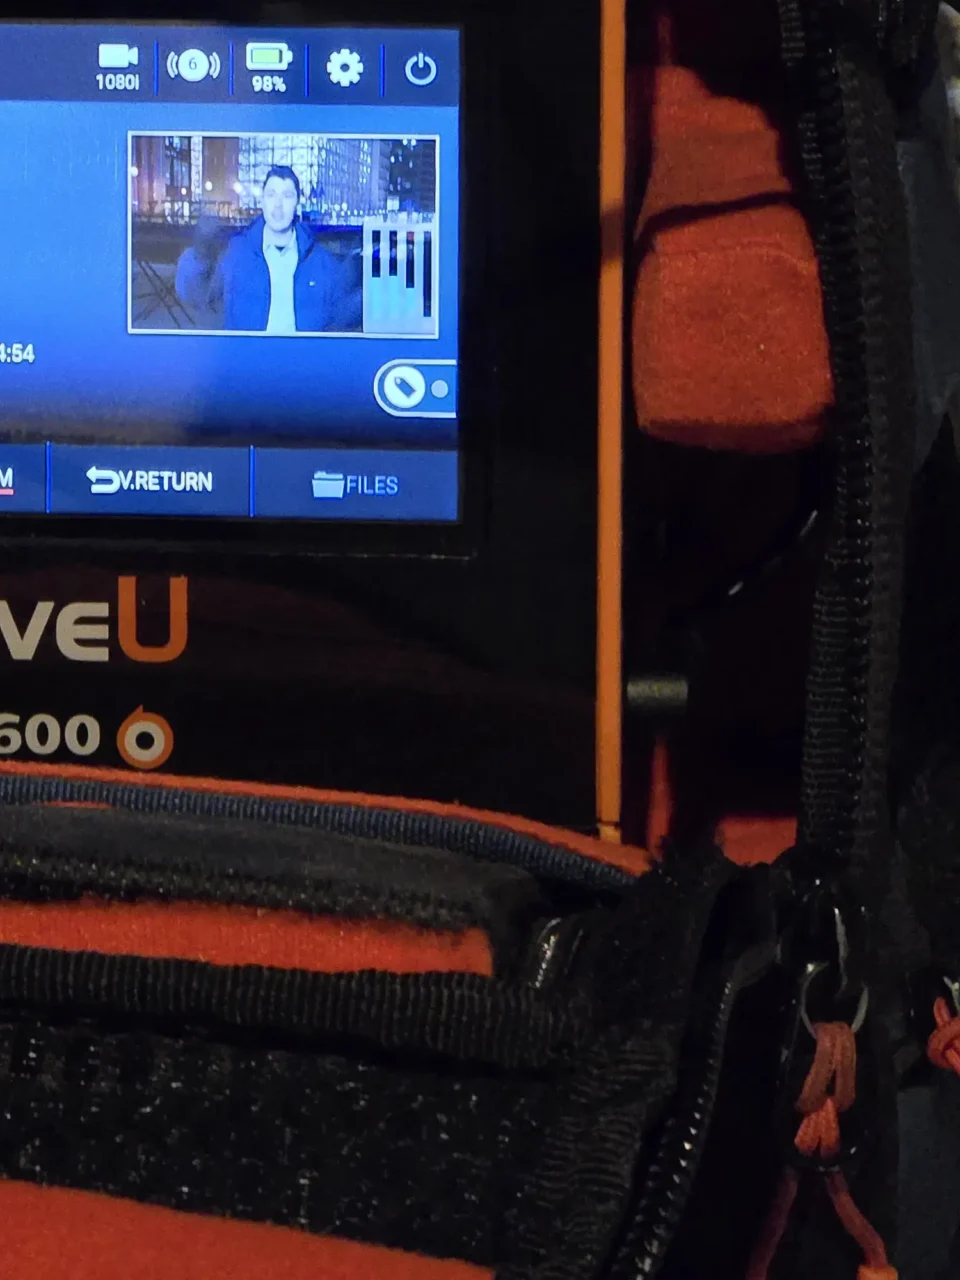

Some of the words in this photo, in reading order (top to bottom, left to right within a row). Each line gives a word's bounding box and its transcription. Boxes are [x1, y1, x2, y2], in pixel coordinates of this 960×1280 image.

[187, 56, 198, 71] 6
[251, 75, 287, 93] 98%
[118, 470, 213, 493] V.RETURN
[346, 475, 399, 497] FILES
